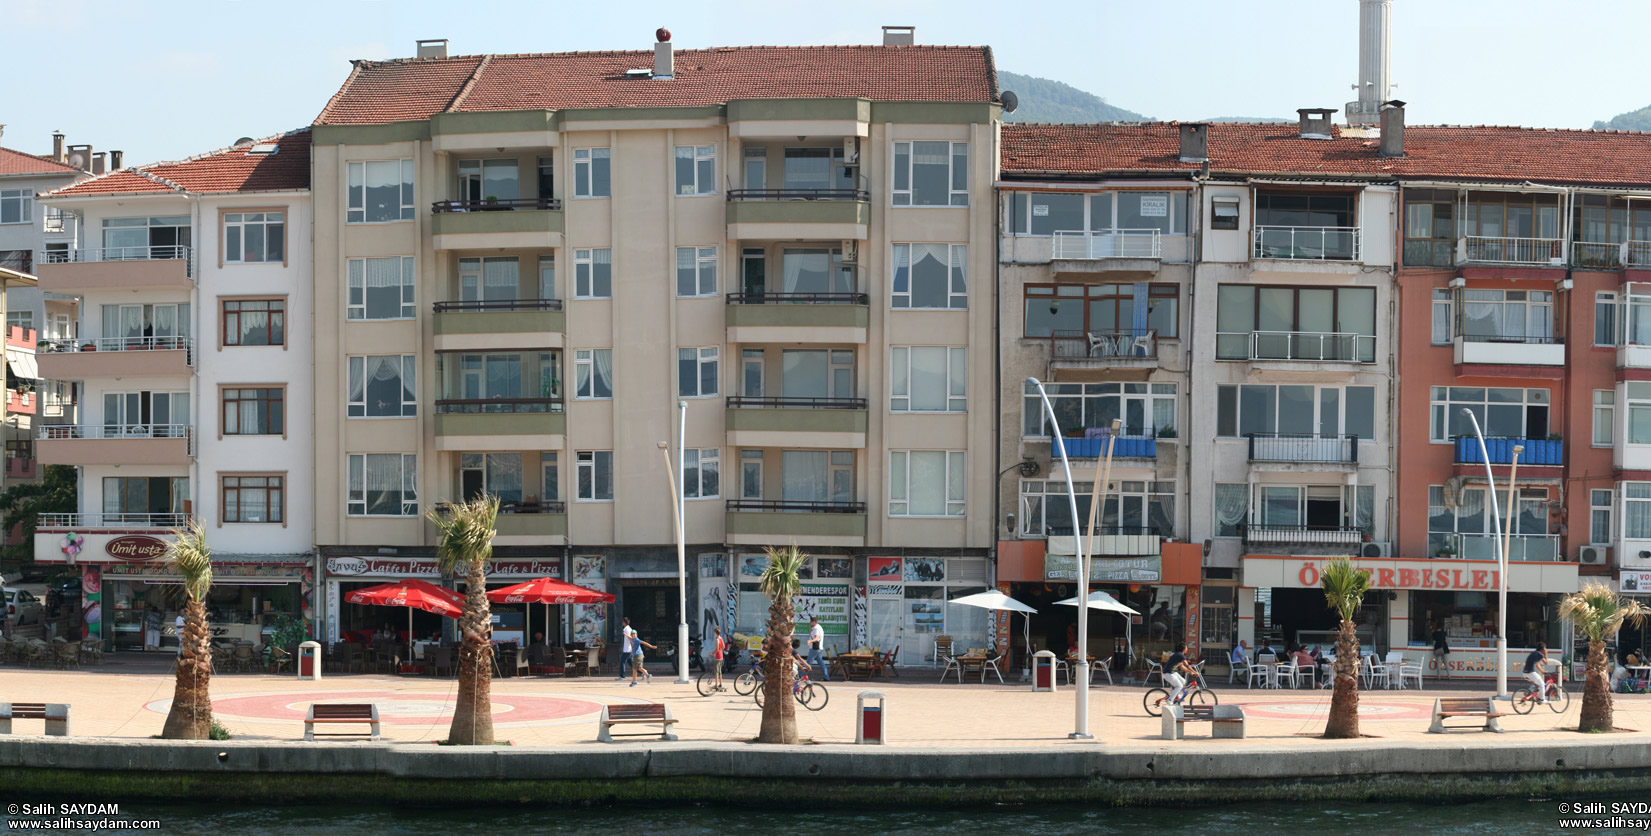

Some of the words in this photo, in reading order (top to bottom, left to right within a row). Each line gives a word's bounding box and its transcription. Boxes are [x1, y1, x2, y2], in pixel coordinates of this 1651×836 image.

[112, 542, 137, 555] Ümit
[138, 545, 160, 555] usta
[494, 560, 518, 574] Cafe
[531, 559, 559, 574] Pizza
